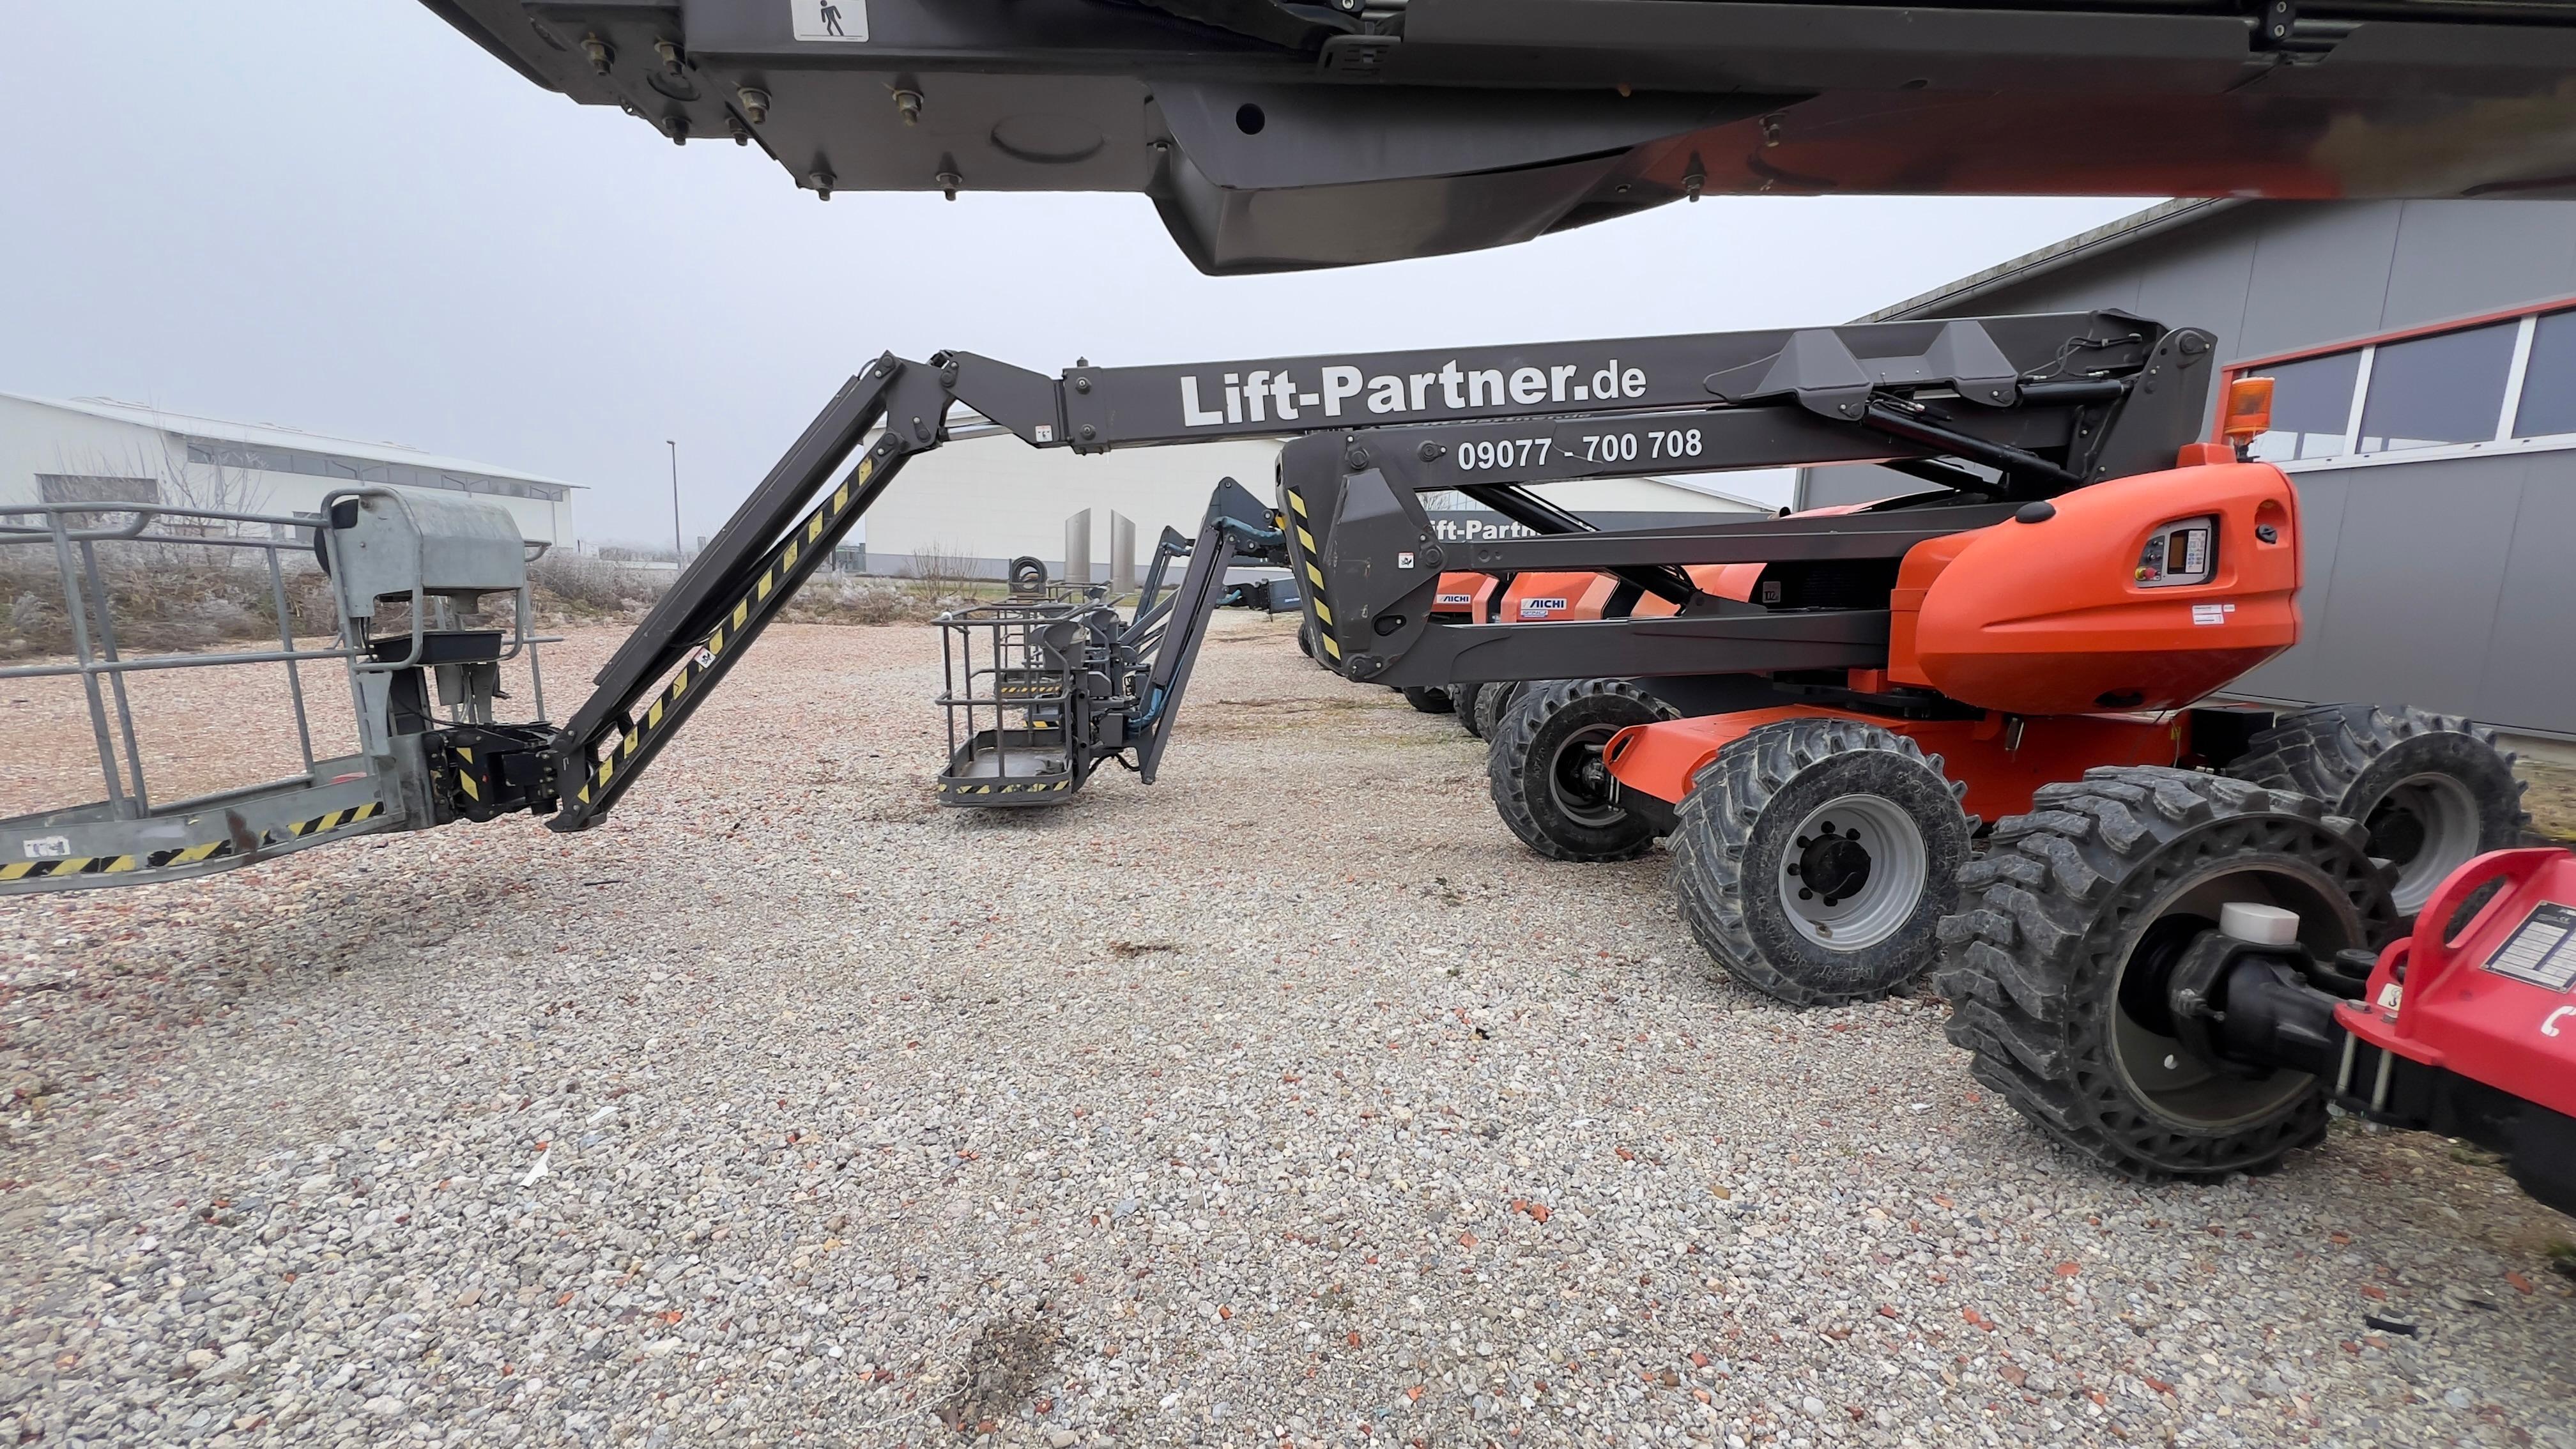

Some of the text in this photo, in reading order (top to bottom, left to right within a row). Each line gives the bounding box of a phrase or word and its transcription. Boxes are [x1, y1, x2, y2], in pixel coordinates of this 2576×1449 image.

[1181, 359, 1646, 427] Lift-Partner.de
[1459, 438, 1552, 470] 09077
[1583, 434, 1637, 462] 700
[1648, 429, 1702, 459] 708
[1430, 519, 1542, 540] ft-Partn
[1530, 600, 1564, 608] AICHI
